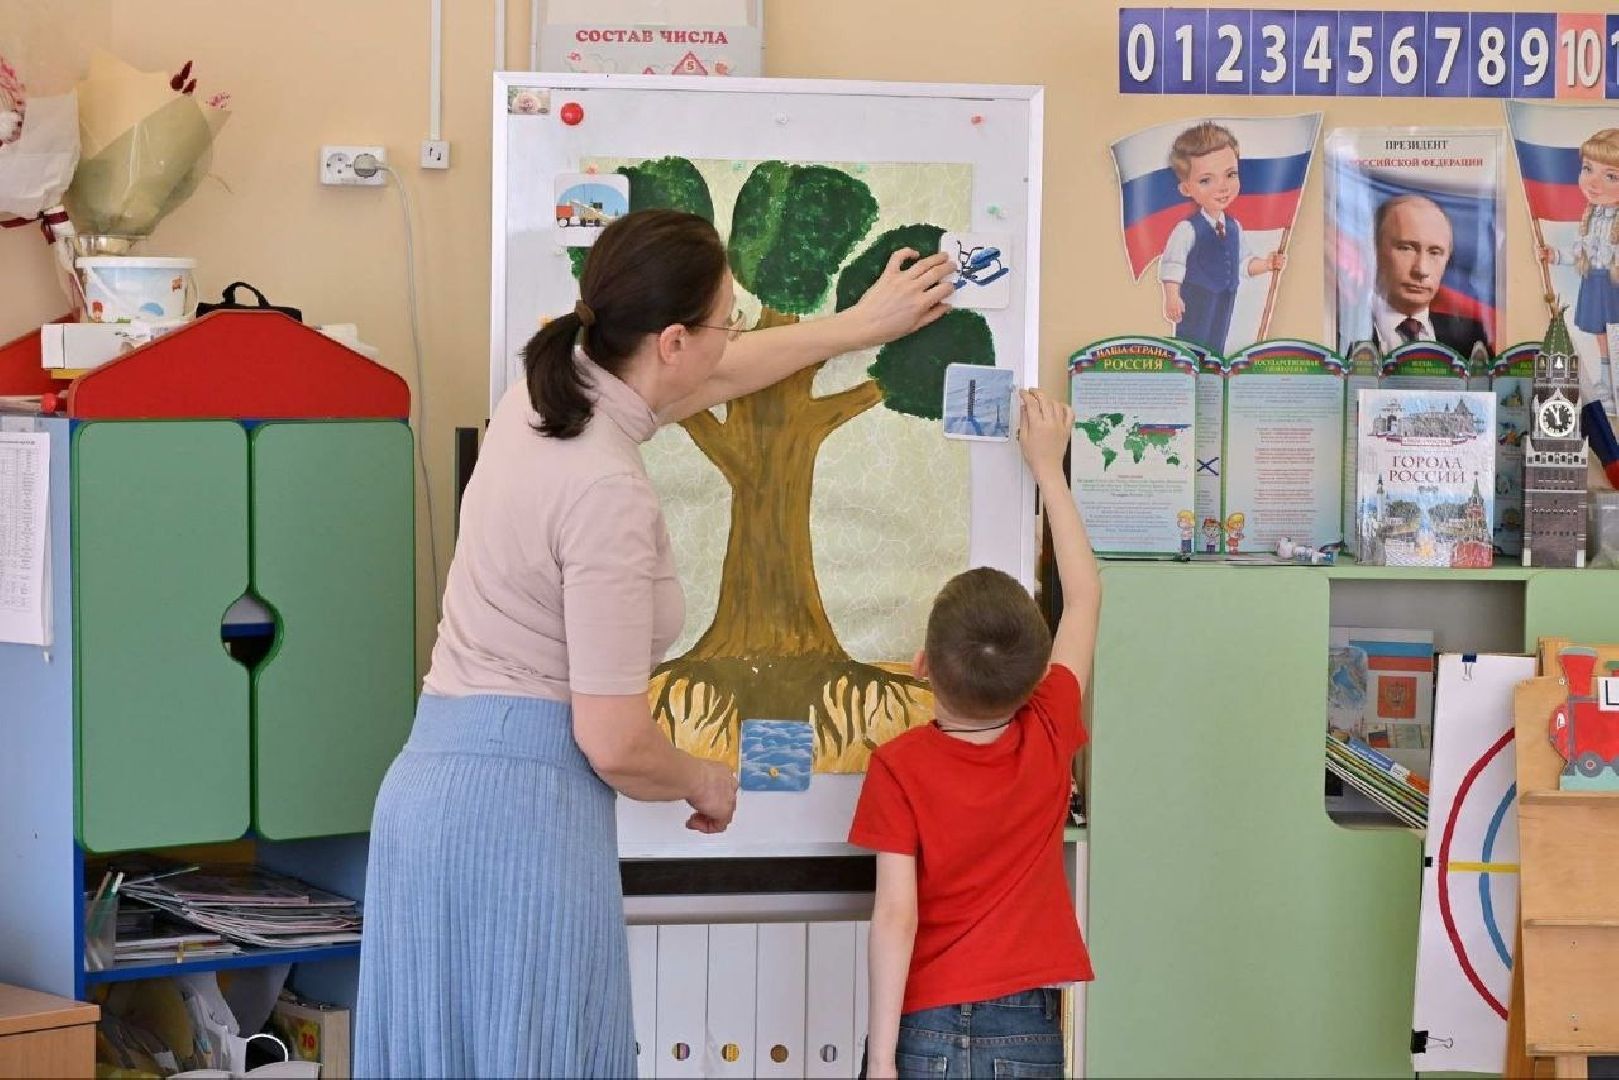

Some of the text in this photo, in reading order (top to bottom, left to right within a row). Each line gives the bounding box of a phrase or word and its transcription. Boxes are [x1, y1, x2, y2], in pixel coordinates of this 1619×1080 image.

[576, 30, 729, 44] СОСТАВ ЧИСЛА
[1127, 24, 1155, 83] 0
[1174, 24, 1193, 81] 1
[1216, 25, 1243, 83] 2
[1260, 25, 1287, 84] 3
[1303, 25, 1332, 83] 4
[1347, 26, 1373, 85] 5
[1389, 25, 1418, 85] 6
[1435, 26, 1461, 85] 7
[1478, 26, 1506, 86] 8
[1520, 26, 1549, 87] 9
[1562, 28, 1602, 88] 10
[1385, 140, 1449, 150] ПРЕЗИДЕНТ
[1348, 158, 1484, 167] ОССИЙСКОЙ ФЕДЕРАЦИИ
[1095, 346, 1126, 358] НАША
[1104, 358, 1163, 370] РОССИЯ
[1392, 455, 1462, 469] ГОРОДА
[1389, 470, 1464, 484] РОССИИ
